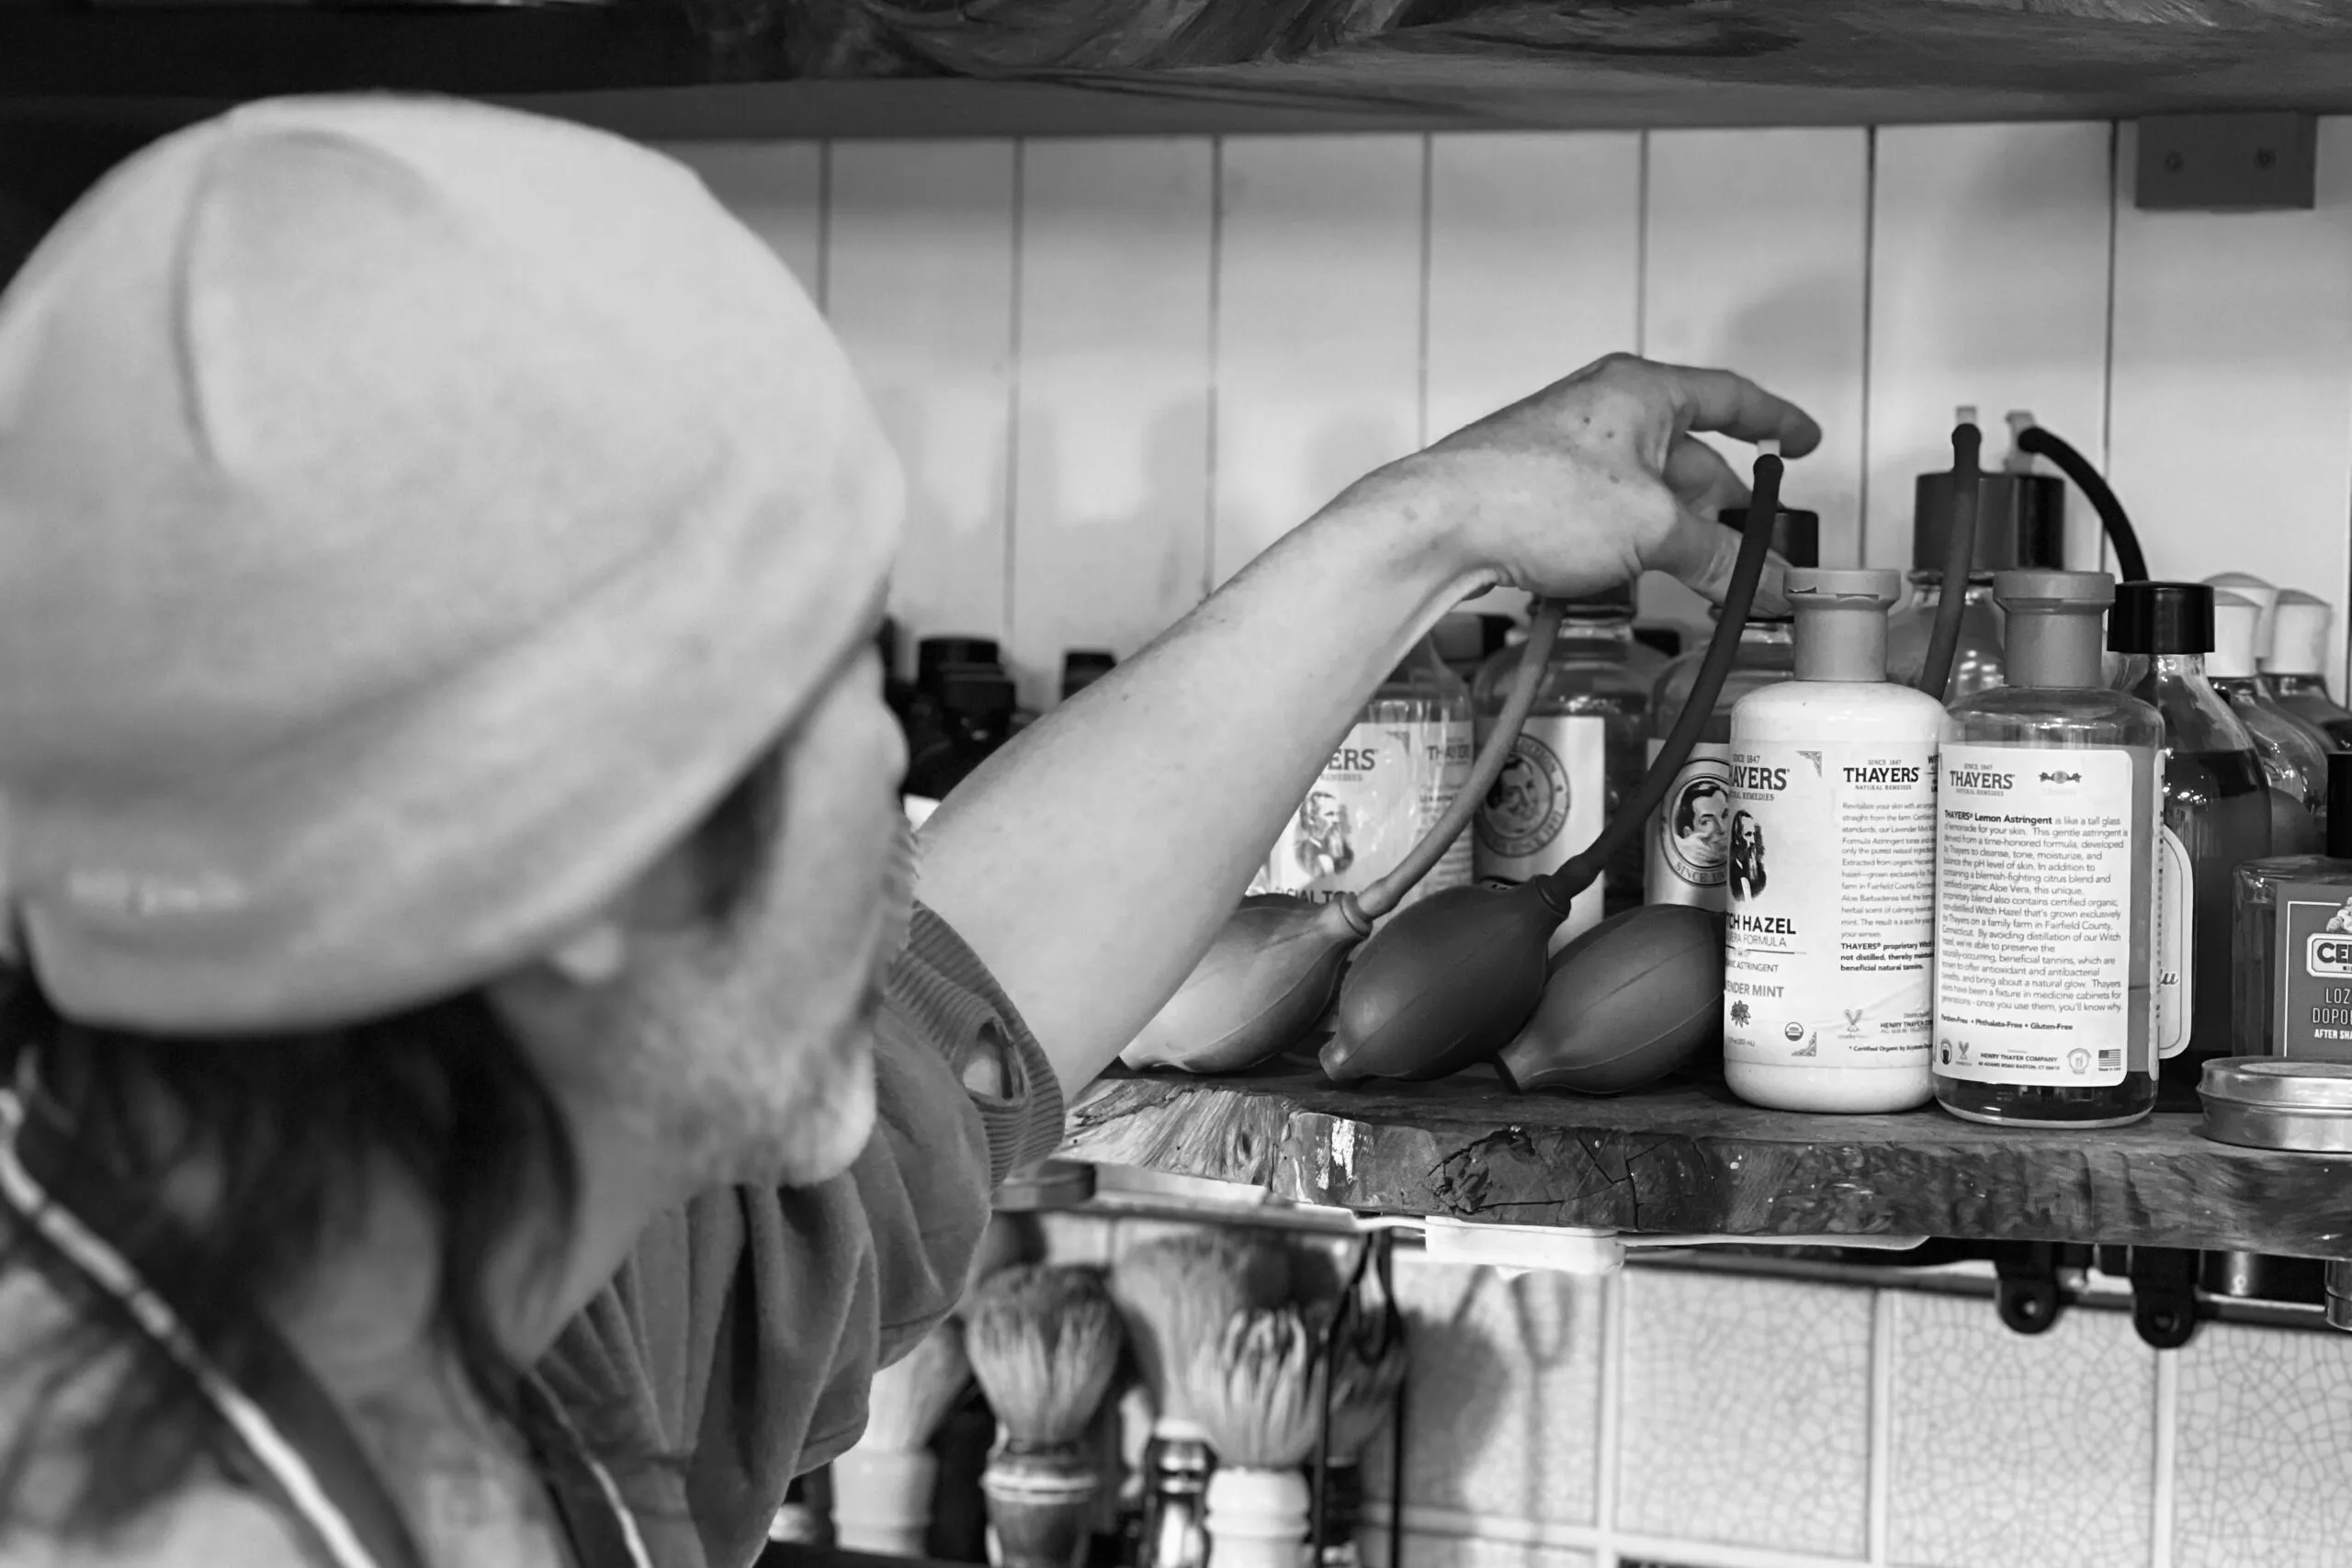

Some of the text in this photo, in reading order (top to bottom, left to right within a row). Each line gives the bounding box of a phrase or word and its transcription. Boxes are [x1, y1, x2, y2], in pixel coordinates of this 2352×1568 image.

[1328, 749, 1376, 771] ERS
[1843, 767, 1920, 783] THAYERS
[1950, 770, 2014, 790] THAYERS
[1743, 792, 1775, 801] REMEDIES
[1842, 814, 1869, 822] straight
[1974, 812, 2002, 823] Lemon
[2003, 814, 2052, 827] Astringent
[2054, 818, 2062, 826] is
[2064, 817, 2078, 826] like
[2087, 817, 2100, 826] tall
[2102, 816, 2121, 828] glass
[1978, 824, 2121, 840] for your This gentle astringent
[1842, 837, 1905, 846] Formula Astringent
[1984, 837, 2041, 848] time-honored
[2081, 839, 2124, 852] developed
[1841, 847, 1857, 856] only
[2086, 851, 2103, 861] and
[1842, 858, 1891, 866] Extracted from
[1973, 859, 1984, 870] pH
[1986, 859, 2005, 869] level
[2006, 861, 2016, 870] of
[2038, 863, 2047, 872] In
[2048, 863, 2085, 872] addition
[1975, 870, 2041, 885] blemish-fighting
[2043, 874, 2067, 884] citrus
[2068, 874, 2094, 884] blend
[2095, 874, 2111, 884] and
[1841, 881, 1858, 889] farm
[1867, 881, 1894, 889] Fairfield
[1989, 882, 2008, 892] Aloe
[2033, 886, 2049, 895] this
[1841, 893, 1859, 901] Aloe
[1994, 895, 2010, 905] also
[2011, 896, 2049, 906] contains
[2050, 897, 2086, 908] certified
[1841, 906, 1864, 914] herbal
[1865, 906, 1883, 914] scent
[1884, 906, 1892, 914] of
[1975, 905, 1997, 916] Witch
[1998, 906, 2022, 917] Hazel
[2023, 908, 2048, 918] that's
[2050, 910, 2078, 920] grown
[2079, 909, 2121, 920] exclusively
[1743, 915, 1797, 935] HAZEL
[1860, 918, 1893, 926] The result
[1987, 917, 2011, 930] family
[2013, 919, 2033, 929] farm
[2034, 921, 2043, 930] in
[2045, 919, 2081, 931] Fairfield
[1744, 933, 1787, 947] FORMULA
[1841, 931, 1857, 940] your
[1978, 928, 2121, 942] By avoiding distillation of our Witch
[1883, 942, 1918, 952] proprietary
[1973, 941, 2055, 953] able to preserve the
[1841, 953, 1854, 962] not
[1887, 952, 1913, 962] thereby
[1999, 953, 2041, 964] beneficial
[2077, 955, 2102, 965] which
[2103, 957, 2116, 965] are
[1736, 961, 1780, 972] ASTRINGENT
[1841, 962, 1902, 972] beneficial natural
[1982, 965, 2100, 977] antioxidant and antibacterial
[1975, 975, 1996, 987] bring
[1997, 977, 2023, 987] about
[2031, 979, 2063, 988] natural
[2091, 978, 2121, 990] Thayers
[1752, 984, 1785, 998] MINT
[1995, 987, 2022, 998] fixture
[2033, 991, 2075, 1000] medicine
[2075, 991, 2110, 1000] cabinets
[2111, 989, 2121, 999] for
[1975, 999, 1995, 1008] once
[1996, 1001, 2012, 1011] you
[2014, 1002, 2030, 1010] use
[2058, 1002, 2083, 1013] you'll
[2083, 1002, 2107, 1012] know
[1881, 1021, 1902, 1029] HENRY
[2030, 1021, 2074, 1031] Gluten-Free
[2314, 1028, 2338, 1040] AFTER
[1980, 1052, 1999, 1060] HENRY
[2025, 1055, 2058, 1063] COMPANY
